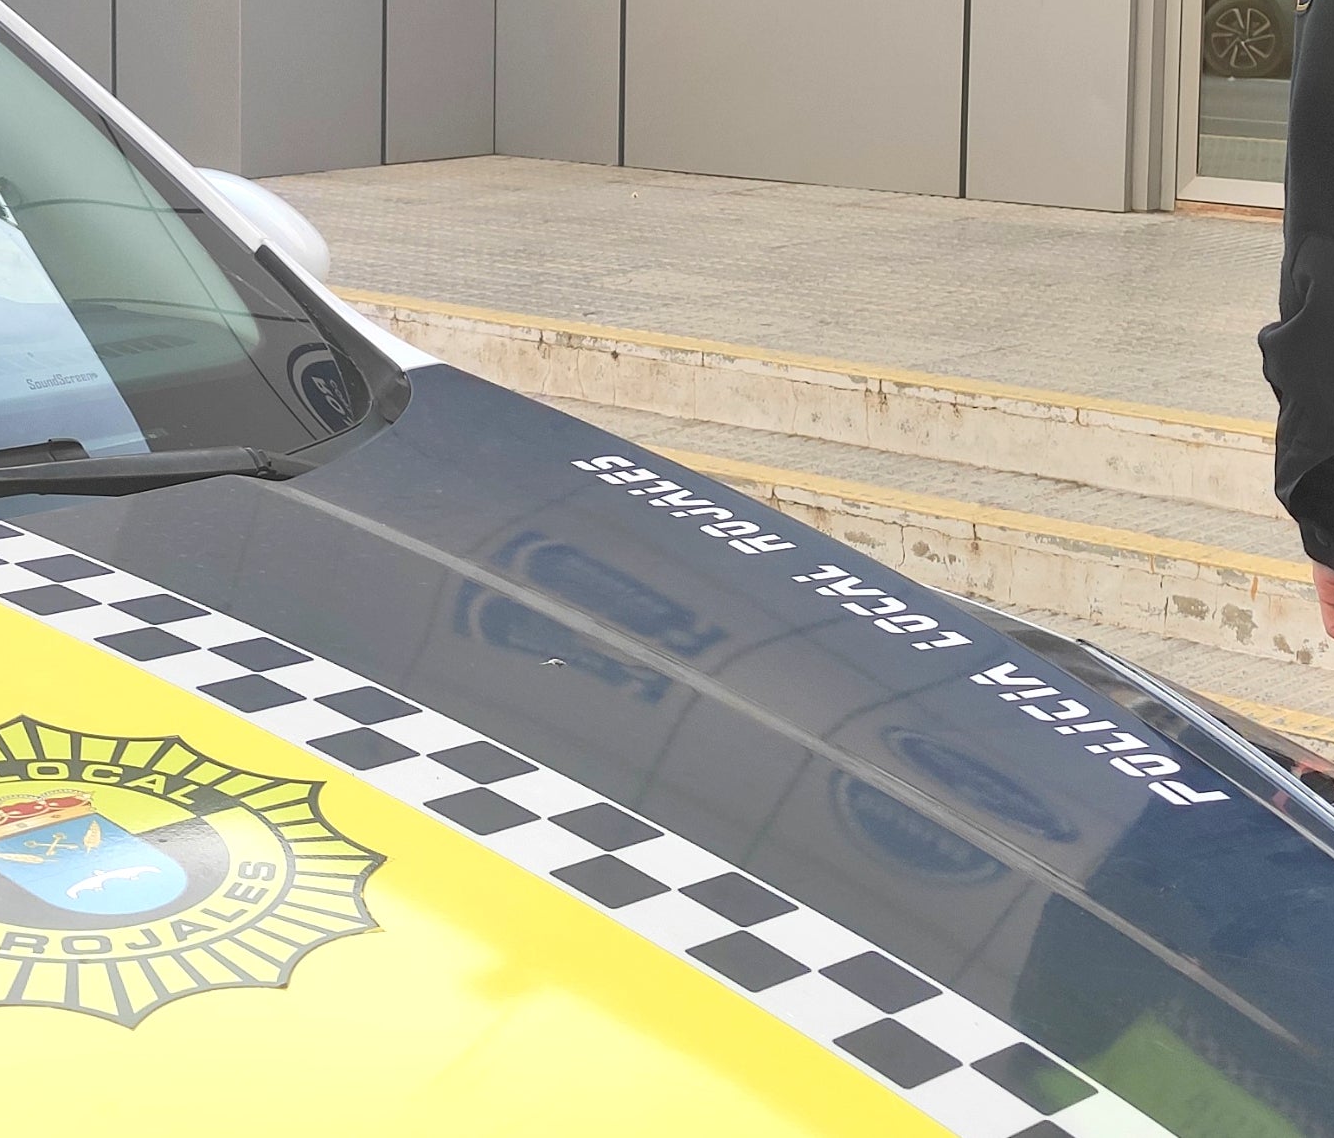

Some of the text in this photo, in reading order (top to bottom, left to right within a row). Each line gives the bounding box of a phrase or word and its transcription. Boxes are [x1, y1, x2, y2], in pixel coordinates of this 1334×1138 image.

[570, 453, 1232, 808] POLICIA LOCAL ROJALES
